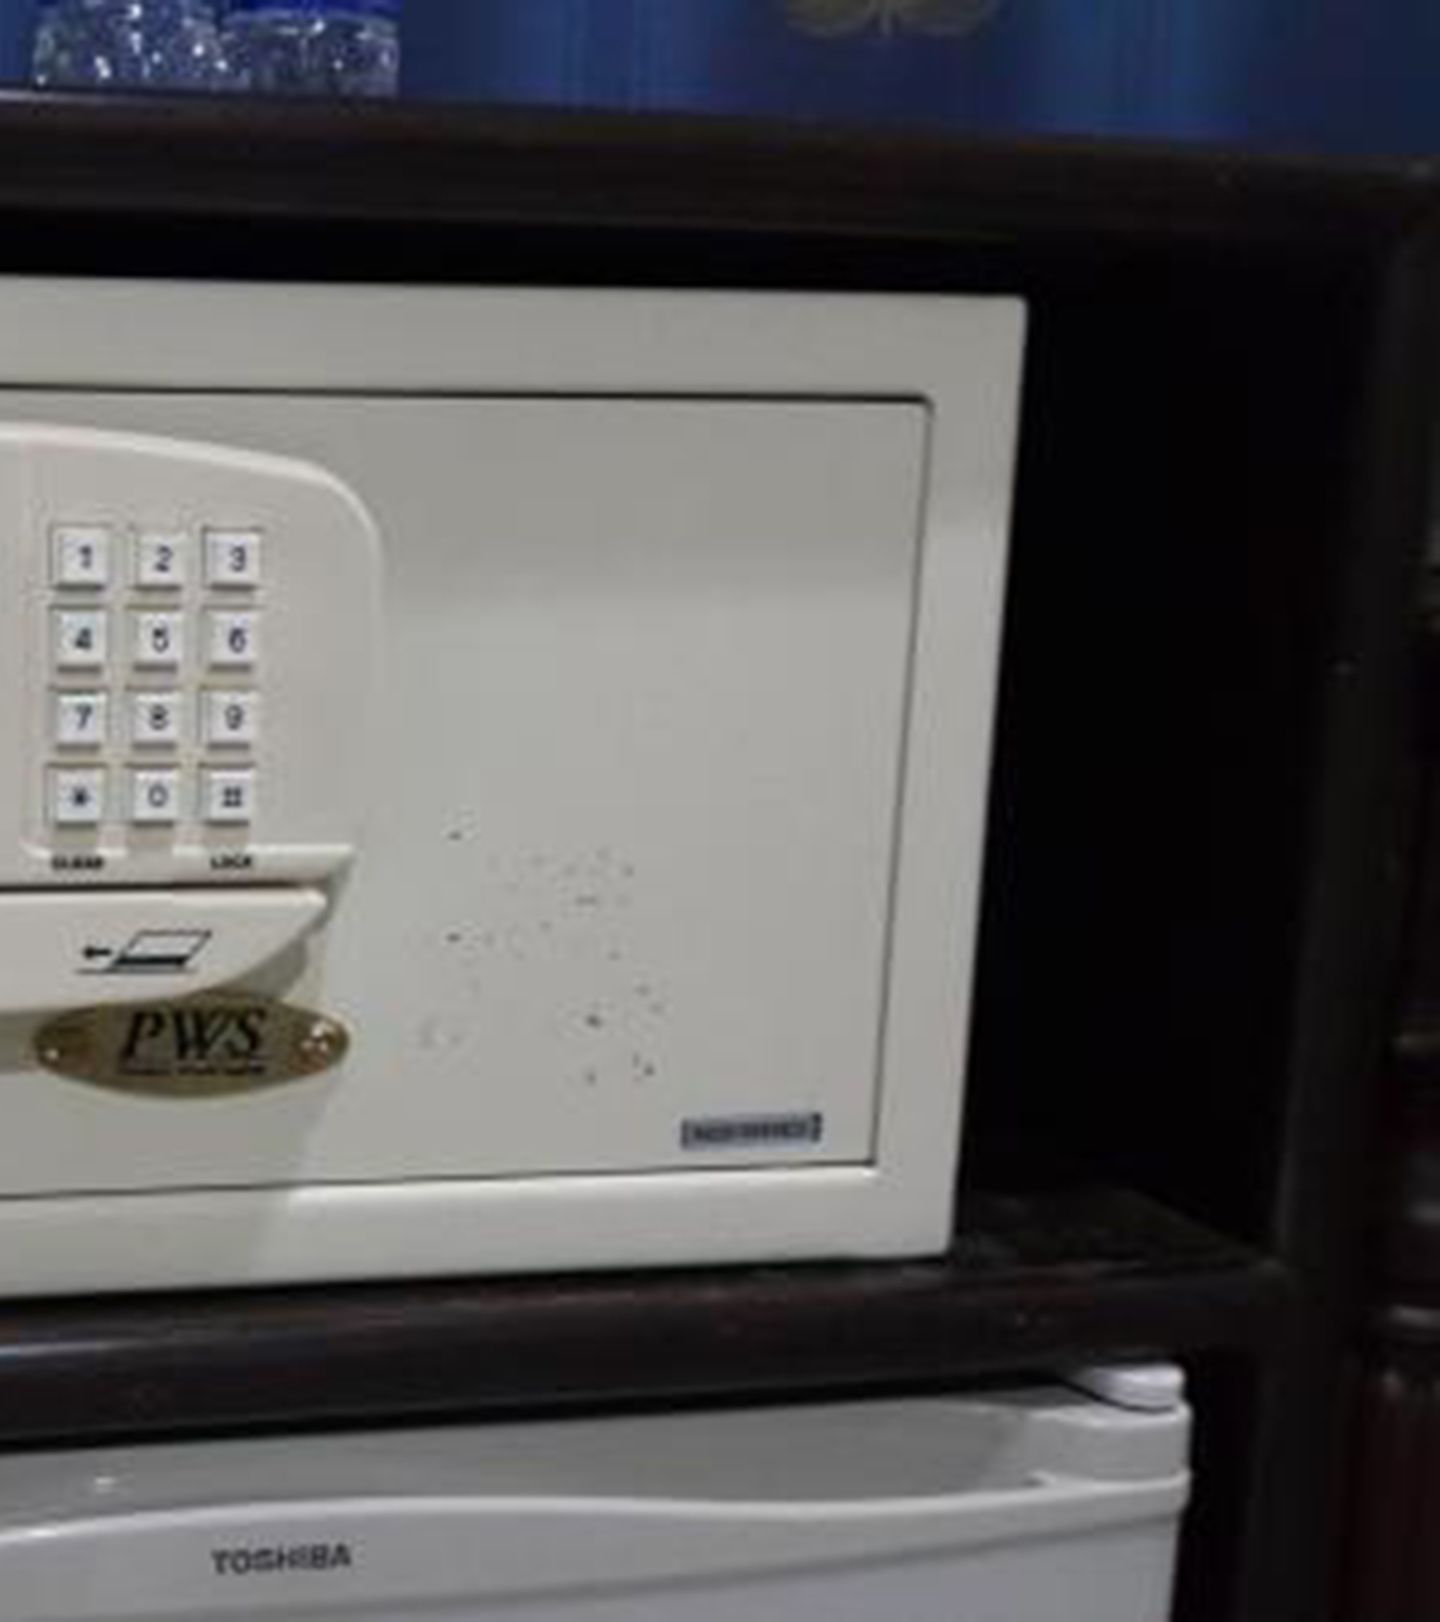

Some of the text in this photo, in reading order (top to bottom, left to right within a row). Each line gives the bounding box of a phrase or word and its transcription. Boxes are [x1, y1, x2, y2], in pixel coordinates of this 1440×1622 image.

[76, 544, 247, 573] 1 2 3
[73, 627, 247, 654] 4 5 6
[75, 703, 244, 731] 7 8 9
[210, 855, 253, 870] LOCK
[120, 1007, 267, 1062] PWS
[211, 1542, 353, 1576] TOSHIBA
